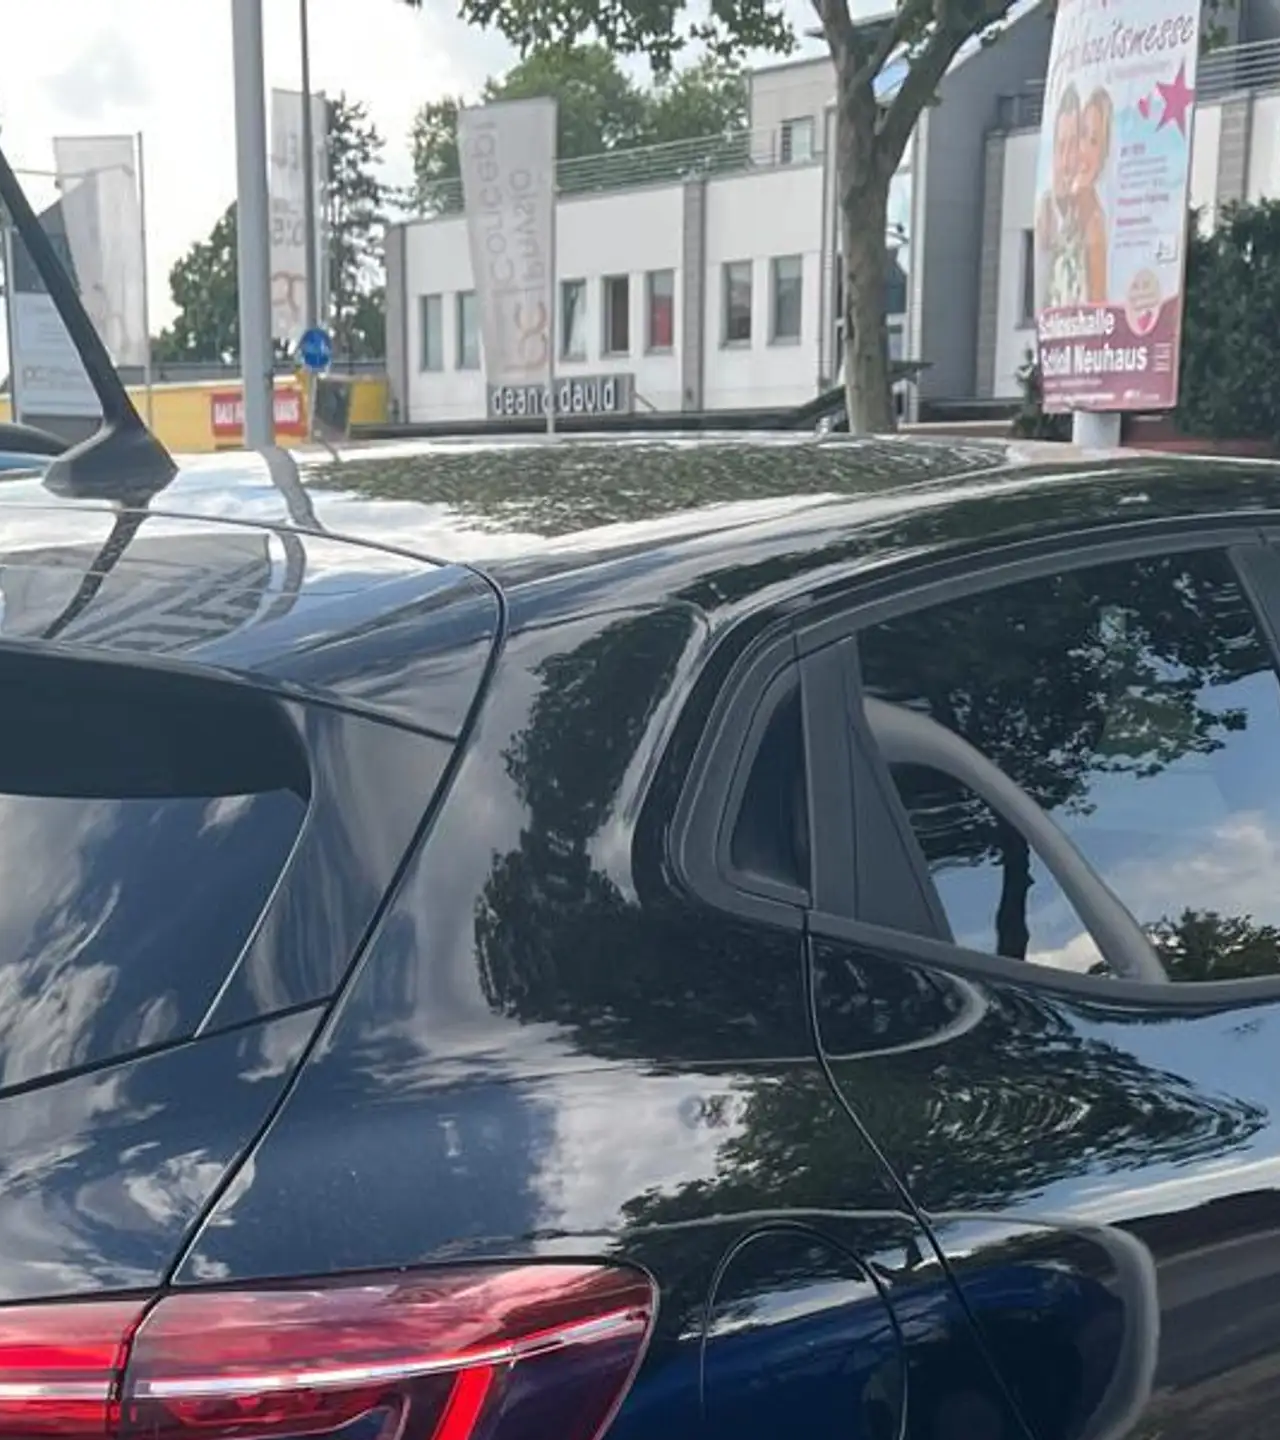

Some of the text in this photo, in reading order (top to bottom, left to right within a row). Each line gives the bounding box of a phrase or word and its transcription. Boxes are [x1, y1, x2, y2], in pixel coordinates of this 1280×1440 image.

[1073, 342, 1148, 373] Neuhaus
[492, 386, 538, 416] dean
[560, 376, 615, 413] david
